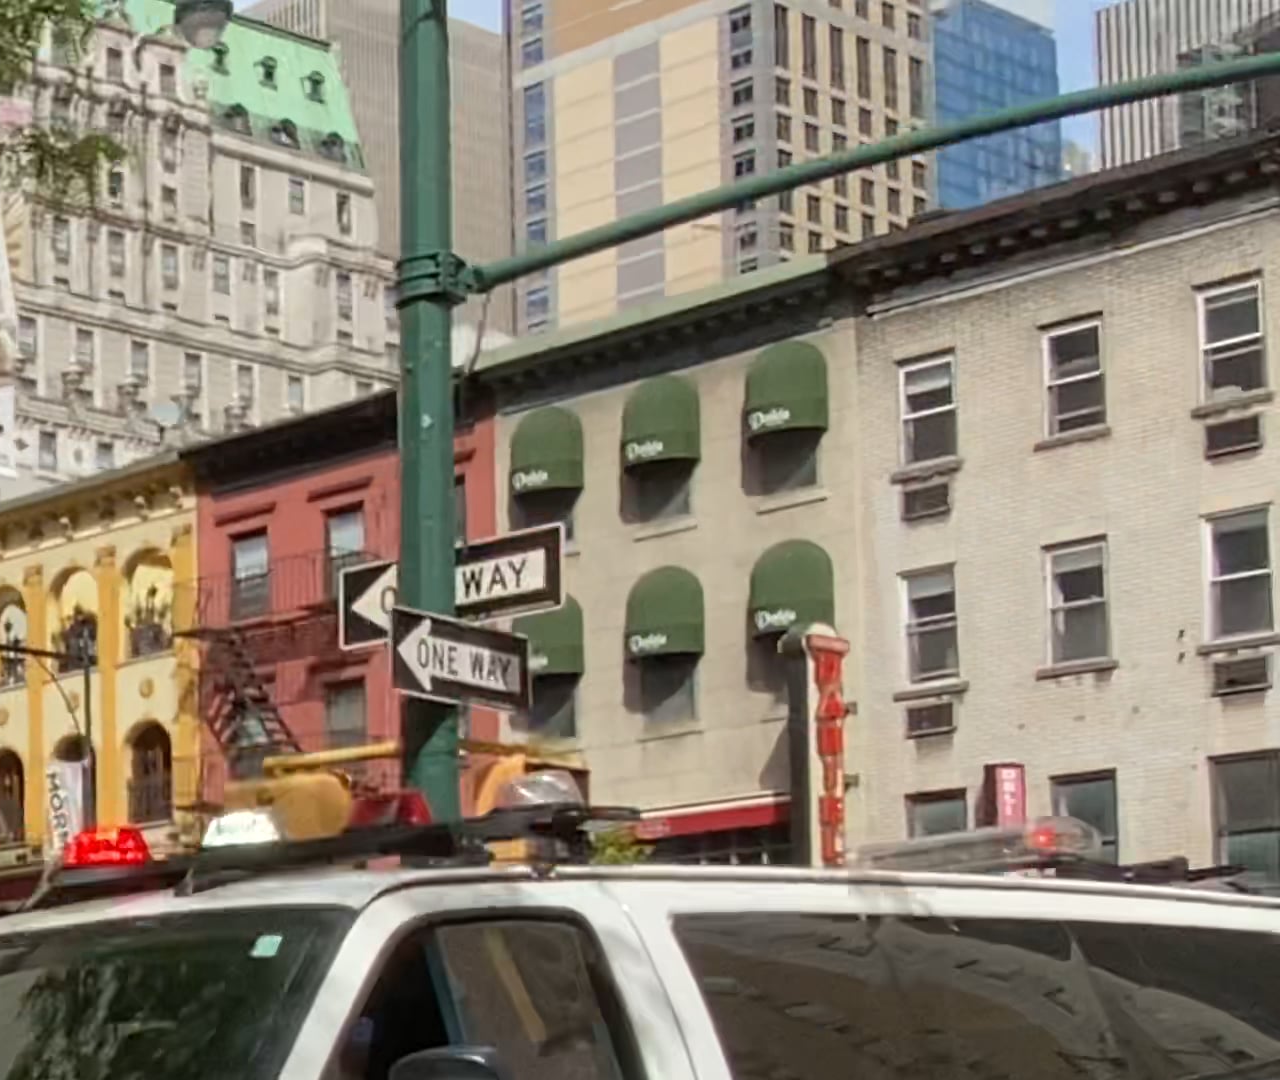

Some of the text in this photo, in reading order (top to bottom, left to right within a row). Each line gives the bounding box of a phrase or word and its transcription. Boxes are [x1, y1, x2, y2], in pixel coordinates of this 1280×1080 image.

[462, 557, 528, 600] WAY
[416, 637, 512, 688] ONE WAY
